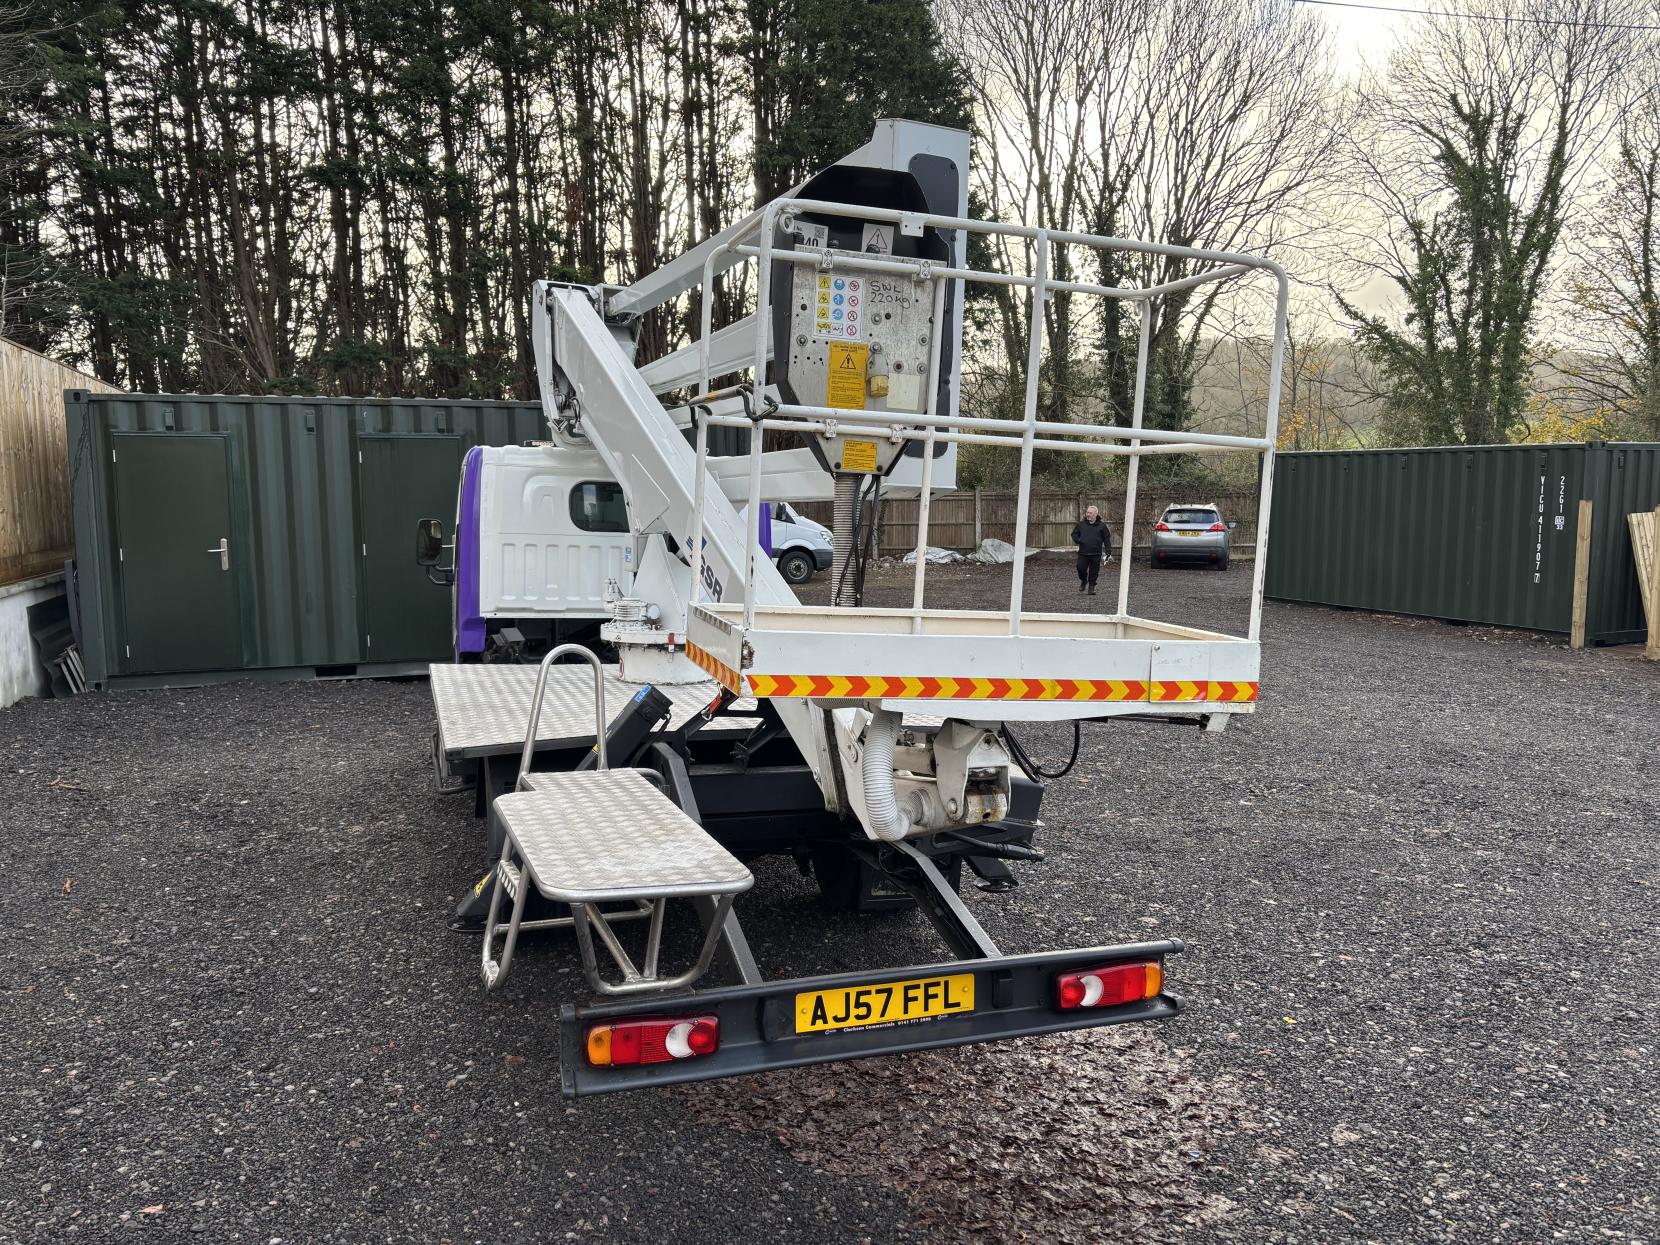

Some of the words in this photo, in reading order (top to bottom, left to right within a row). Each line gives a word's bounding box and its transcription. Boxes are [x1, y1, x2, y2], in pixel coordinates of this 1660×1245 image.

[870, 280, 901, 293] SWL
[1535, 515, 1543, 570] 411907
[810, 987, 893, 1026] AJ57
[903, 980, 961, 1015] FFL
